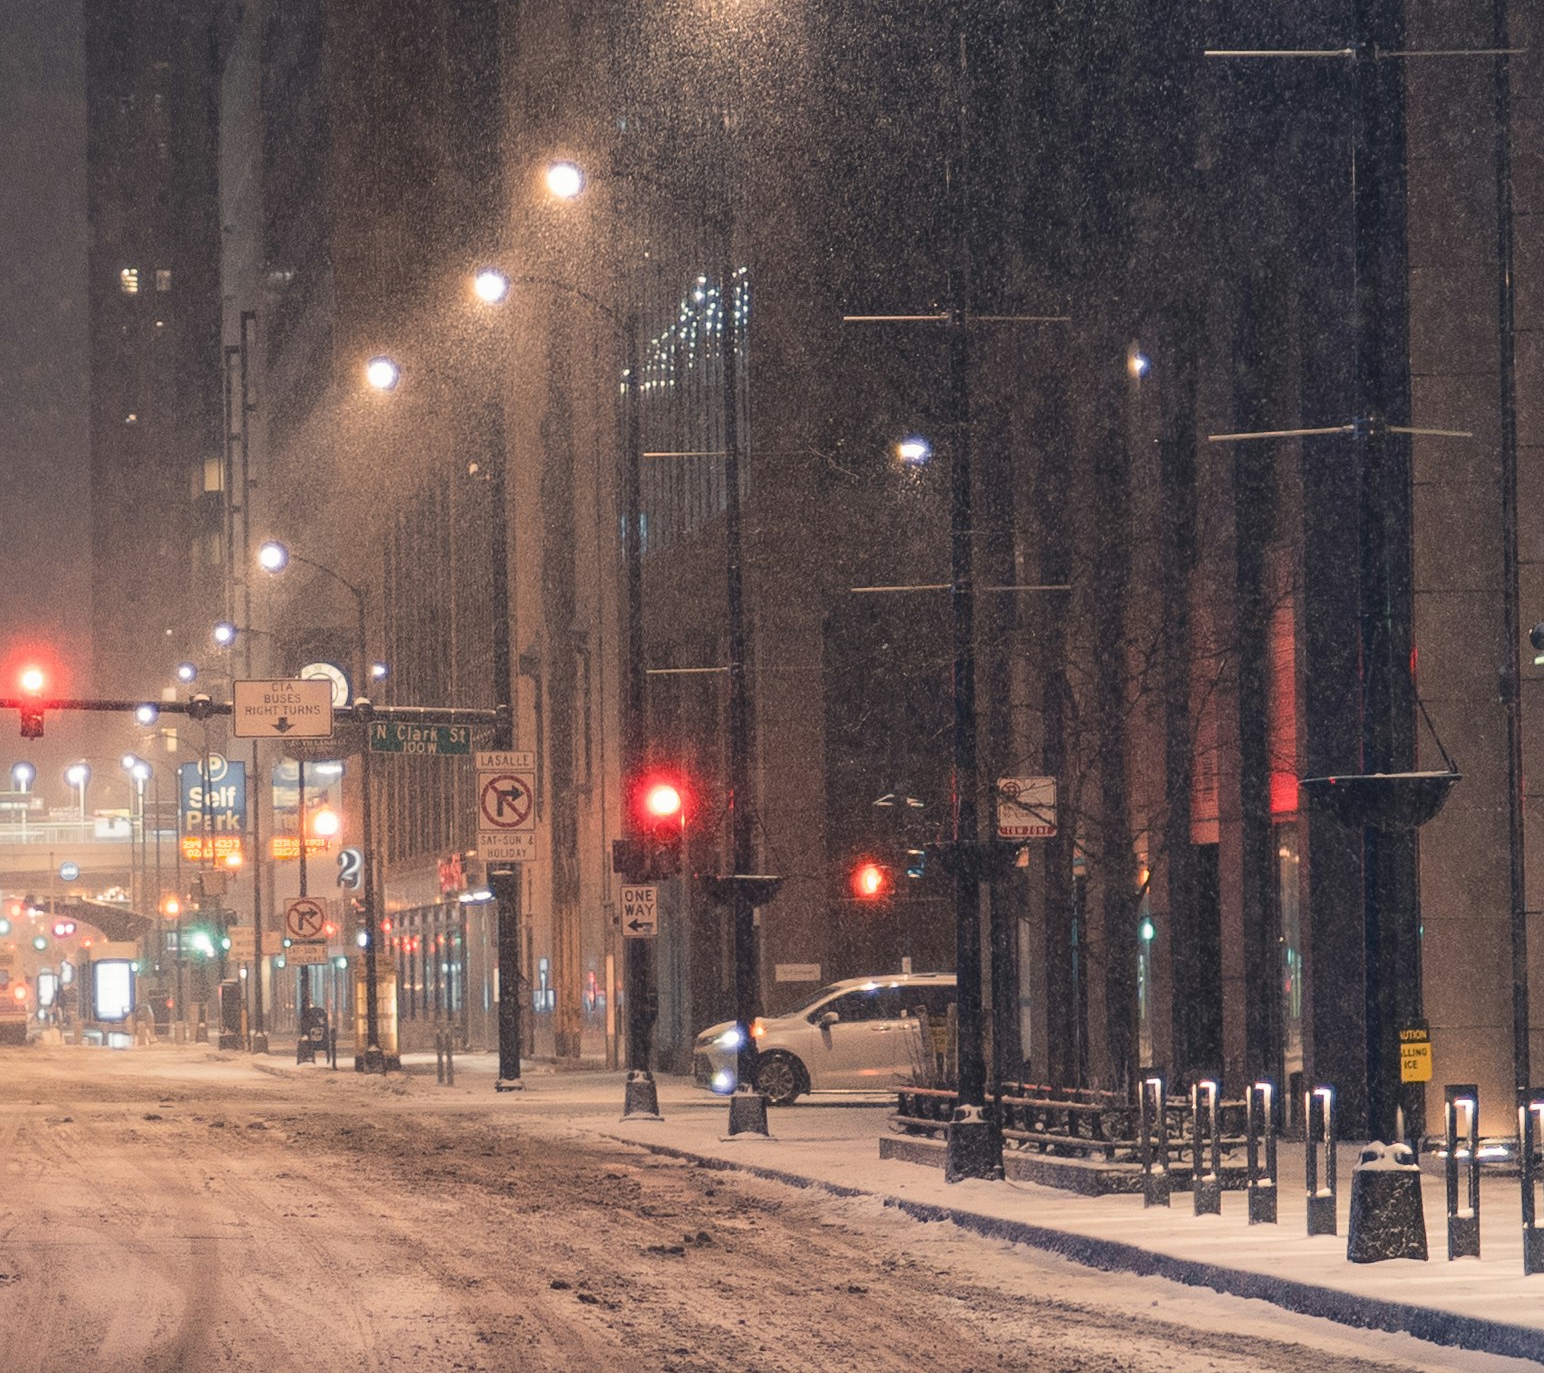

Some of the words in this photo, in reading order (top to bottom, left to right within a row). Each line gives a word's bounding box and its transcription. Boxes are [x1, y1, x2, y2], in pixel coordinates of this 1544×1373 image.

[271, 683, 295, 692] CTA
[264, 694, 301, 703] BUSES
[245, 706, 279, 715] RIGHT
[282, 705, 321, 715] TURNS
[377, 725, 387, 739] N
[397, 725, 438, 741] Clark
[449, 727, 466, 743] St
[481, 755, 530, 766] LASALLE
[189, 786, 236, 808] Self
[186, 811, 241, 831] Park
[480, 835, 522, 845] SAT-SUN
[487, 849, 527, 858] HOLIDAY
[624, 890, 654, 902] ONE
[624, 904, 654, 916] WAY
[1404, 1060, 1417, 1069] ICE
